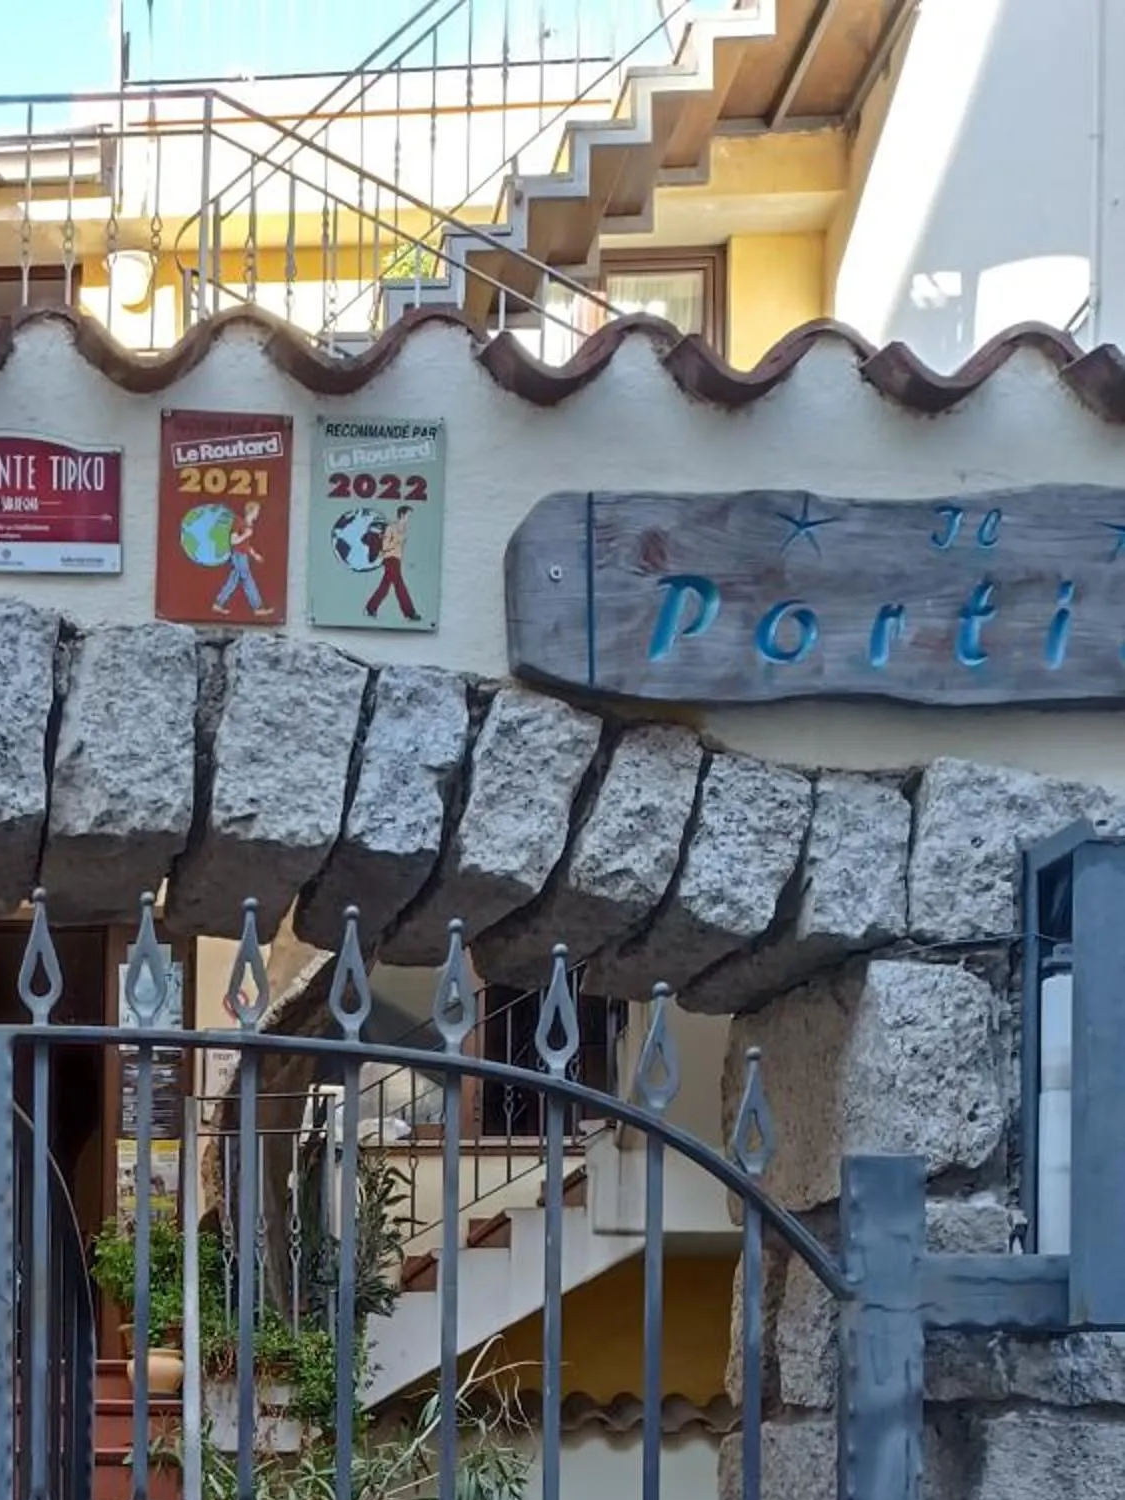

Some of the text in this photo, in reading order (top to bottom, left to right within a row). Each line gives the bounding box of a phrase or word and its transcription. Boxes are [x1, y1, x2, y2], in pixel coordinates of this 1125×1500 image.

[412, 425, 437, 440] PAR
[176, 436, 279, 463] Le Routard
[328, 439, 431, 468] Le Routard
[48, 455, 106, 491] TIPICO
[177, 467, 270, 497] 2021
[327, 471, 429, 501] 2022
[647, 572, 1125, 671] Porti
